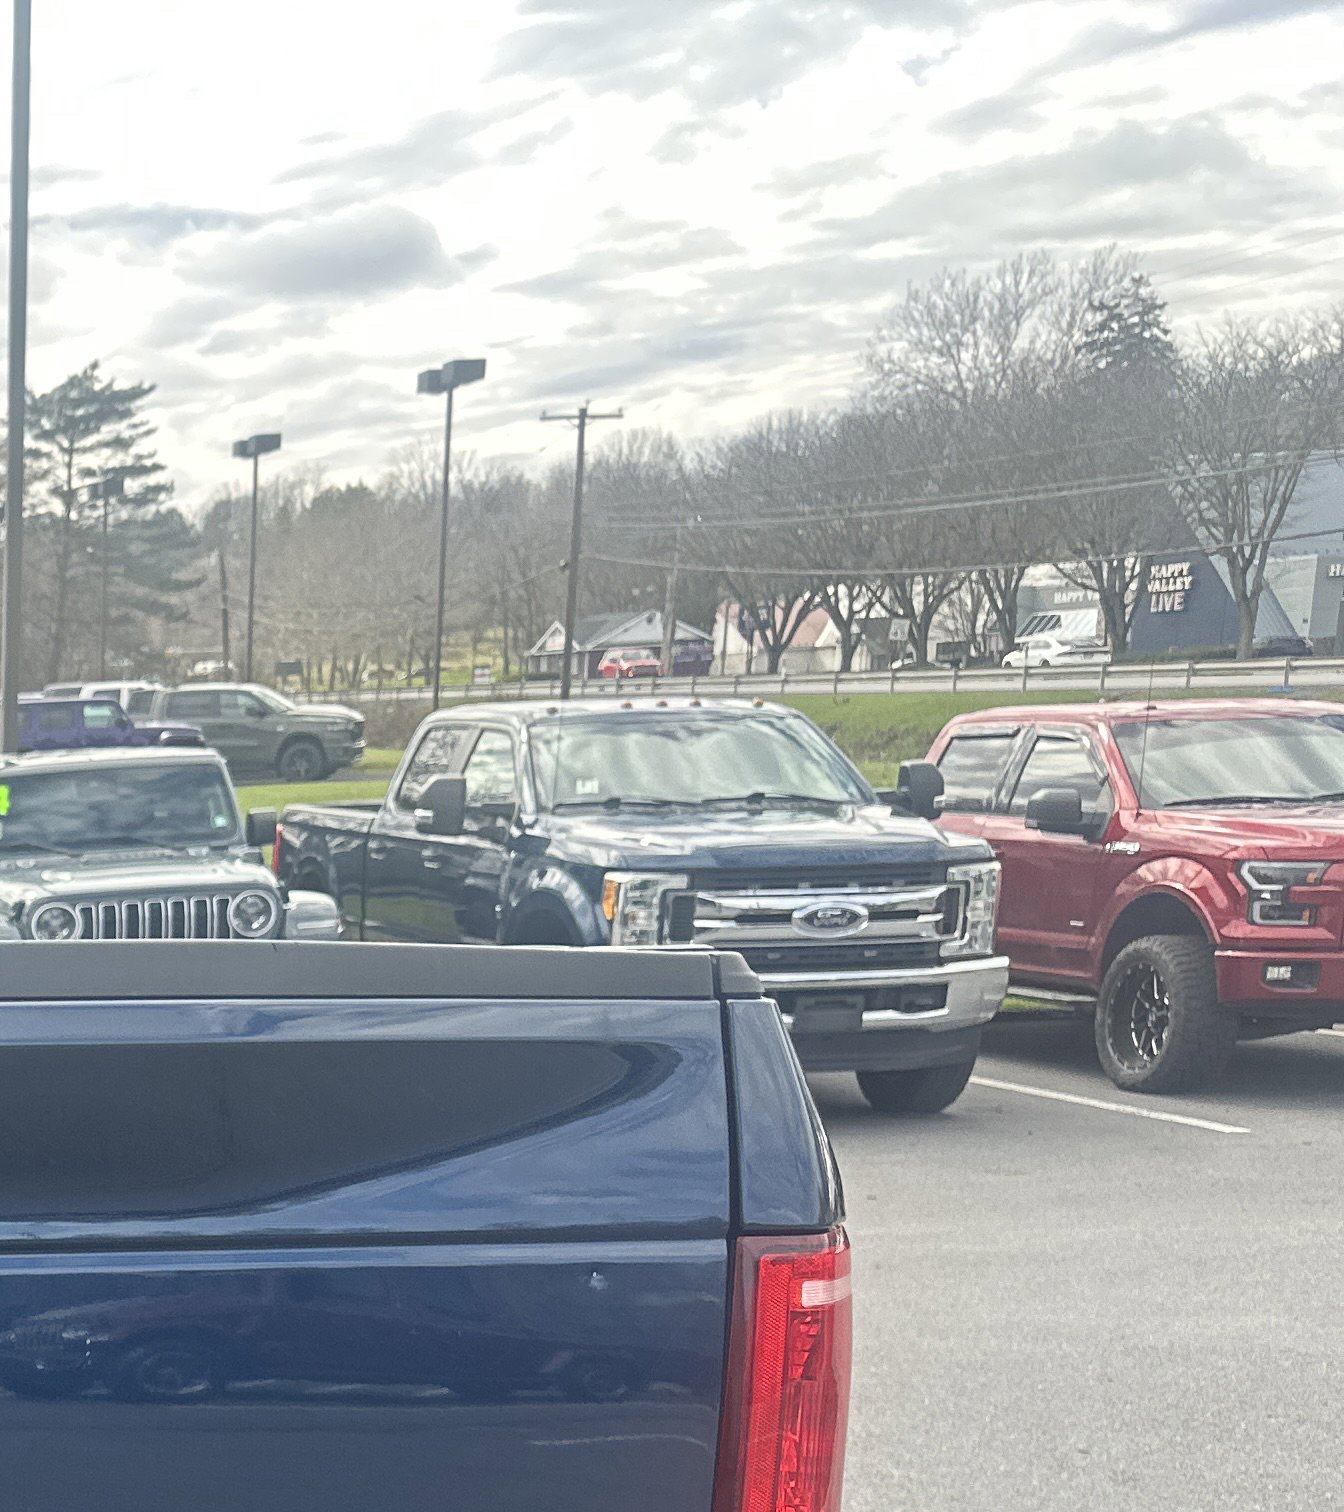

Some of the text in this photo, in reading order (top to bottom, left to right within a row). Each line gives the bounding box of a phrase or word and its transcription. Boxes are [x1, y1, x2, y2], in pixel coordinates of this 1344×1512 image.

[1150, 562, 1190, 579] HAPPY
[1147, 576, 1192, 592] VALLEY
[1150, 592, 1185, 612] LIVE
